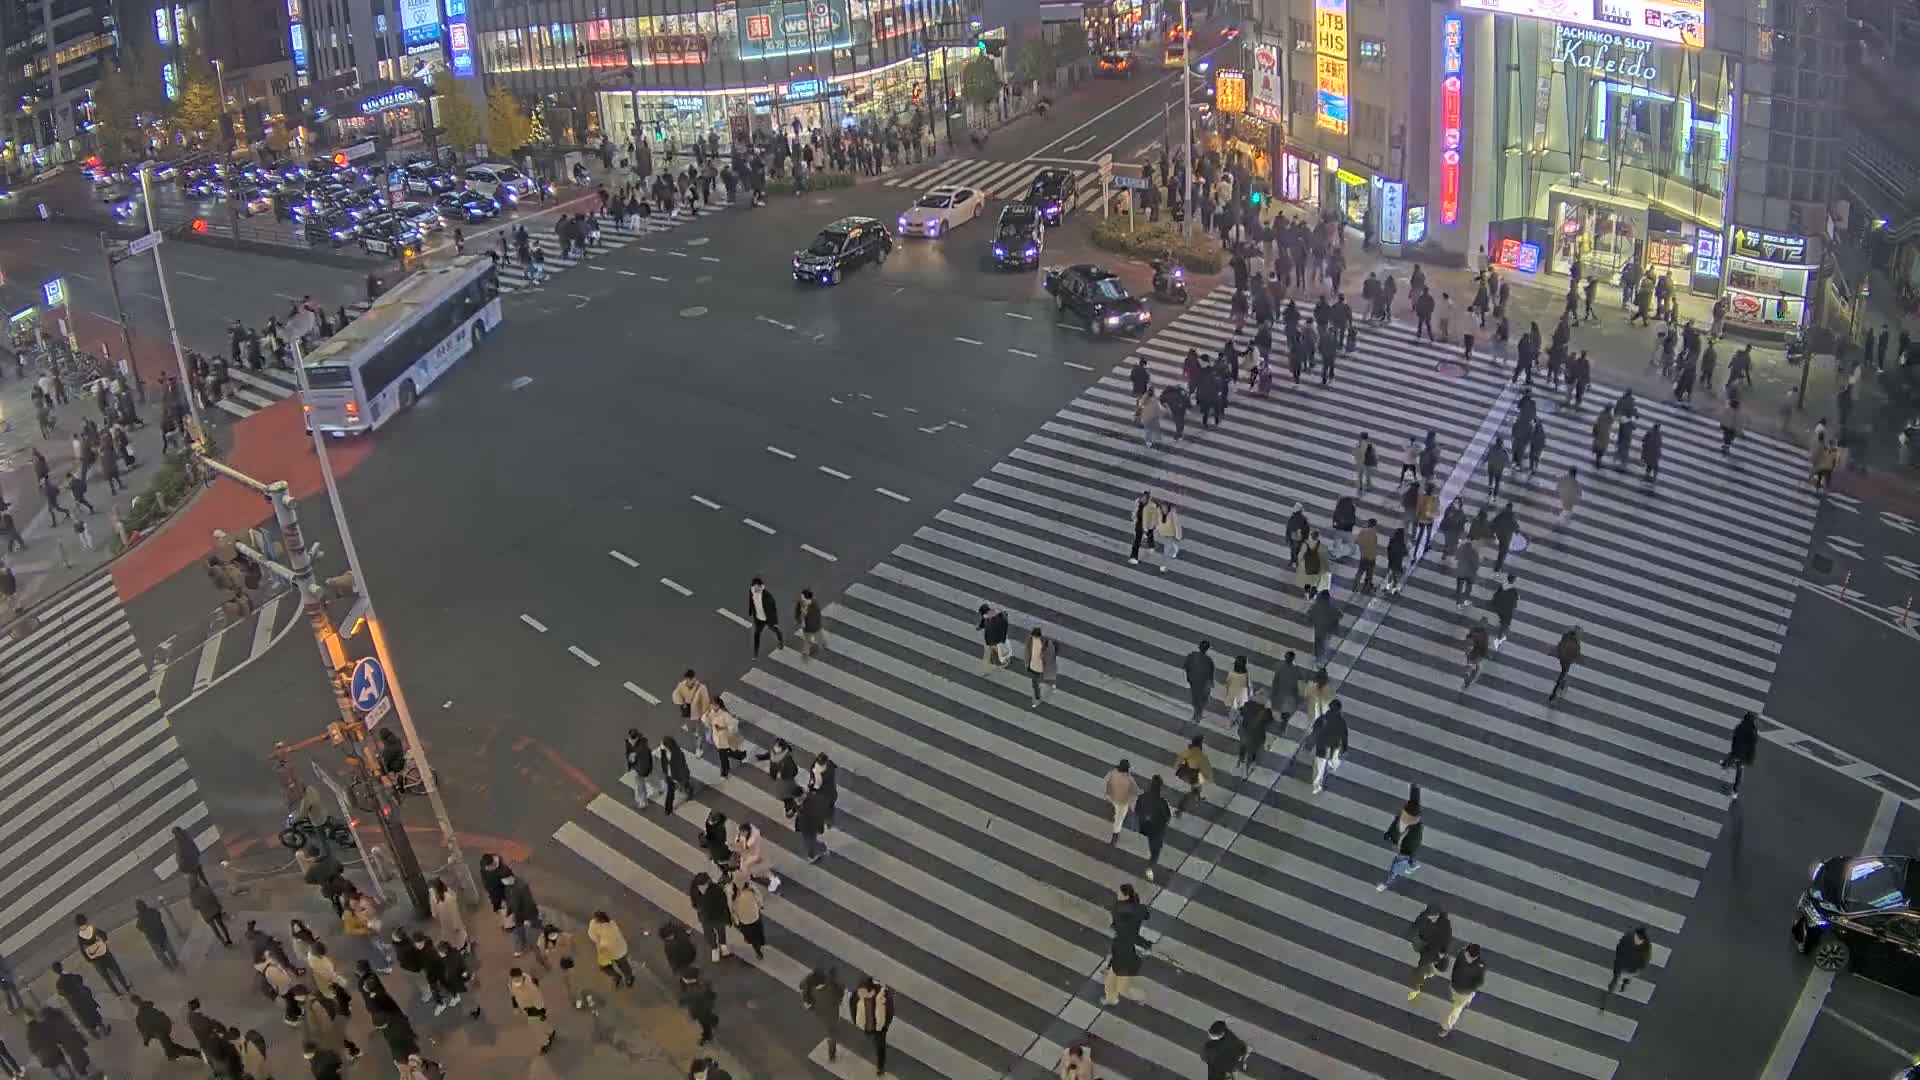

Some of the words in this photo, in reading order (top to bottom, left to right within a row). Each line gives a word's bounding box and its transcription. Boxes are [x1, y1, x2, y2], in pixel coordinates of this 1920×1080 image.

[1319, 11, 1344, 31] JTB
[1319, 31, 1345, 52] HIS
[1557, 26, 1612, 45] PACHINKO
[1614, 36, 1622, 45] &
[1624, 37, 1652, 53] SLOT
[1552, 39, 1657, 80] Kaleido
